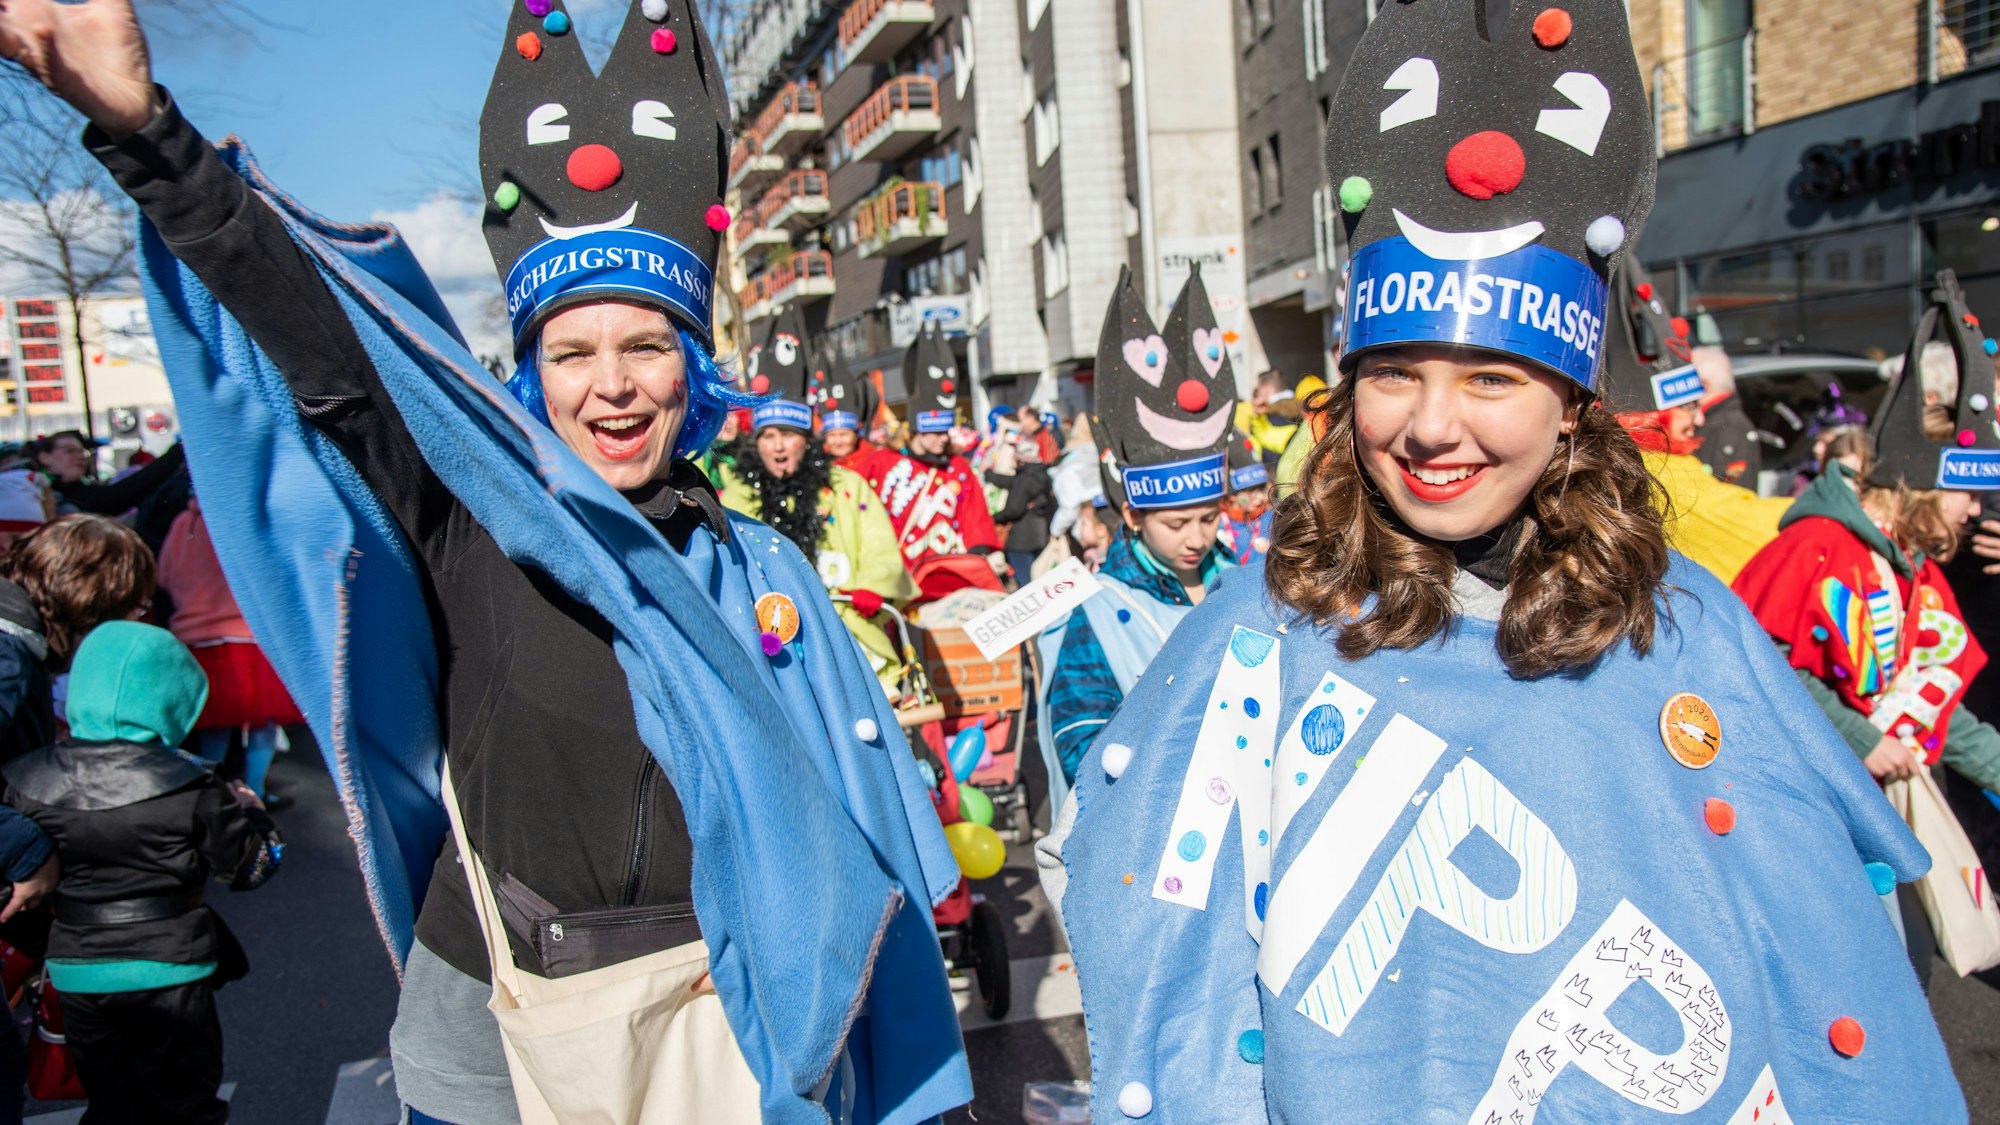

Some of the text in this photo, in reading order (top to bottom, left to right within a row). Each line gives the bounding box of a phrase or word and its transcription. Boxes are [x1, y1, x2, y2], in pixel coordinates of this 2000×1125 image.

[508, 246, 710, 322] SECHZIGSTRASSE
[1353, 270, 1602, 359] FLORASTRASSE
[1944, 460, 2000, 478] NEUSS
[933, 659, 1018, 688] OBI
[1688, 704, 1710, 722] 2020
